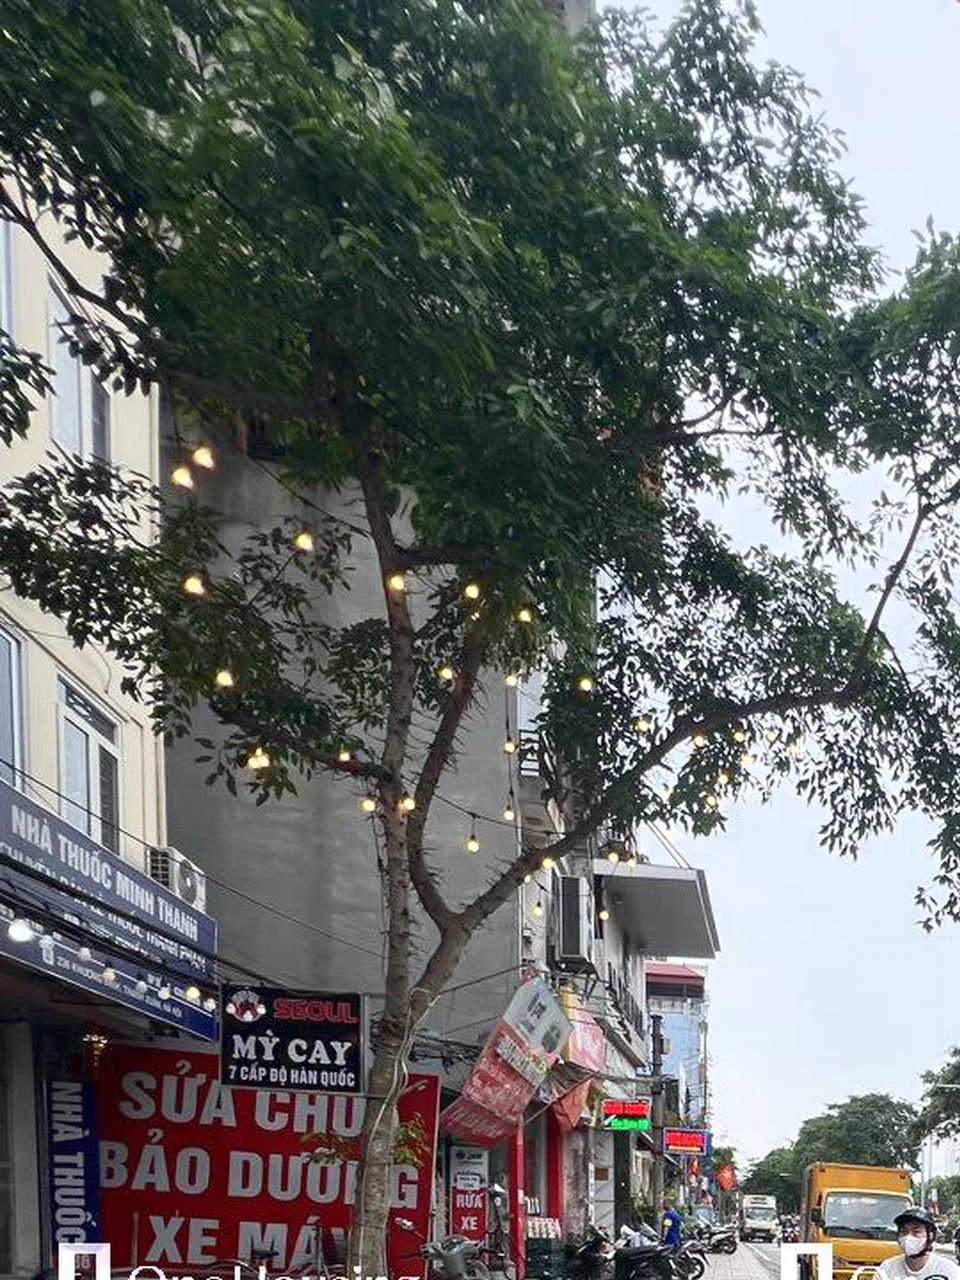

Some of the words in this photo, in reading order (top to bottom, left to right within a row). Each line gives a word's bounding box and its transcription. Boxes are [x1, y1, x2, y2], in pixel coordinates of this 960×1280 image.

[11, 804, 53, 855] NHÀ
[58, 834, 112, 889] THUỐC
[116, 871, 154, 916] MINH
[273, 998, 357, 1024] SEOUL
[231, 1029, 280, 1061] MỲ
[287, 1038, 353, 1066] CAY
[119, 1060, 236, 1128] SỬA
[228, 1065, 237, 1080] 7
[240, 1062, 267, 1082] CẤP
[269, 1065, 287, 1086] ĐỘ
[290, 1067, 318, 1085] HÀN
[320, 1067, 355, 1087] QUỐC
[51, 1081, 91, 1141] NHÀ
[99, 1129, 211, 1196] BẢO
[144, 1214, 222, 1266] XE
[460, 1216, 479, 1231] XE
